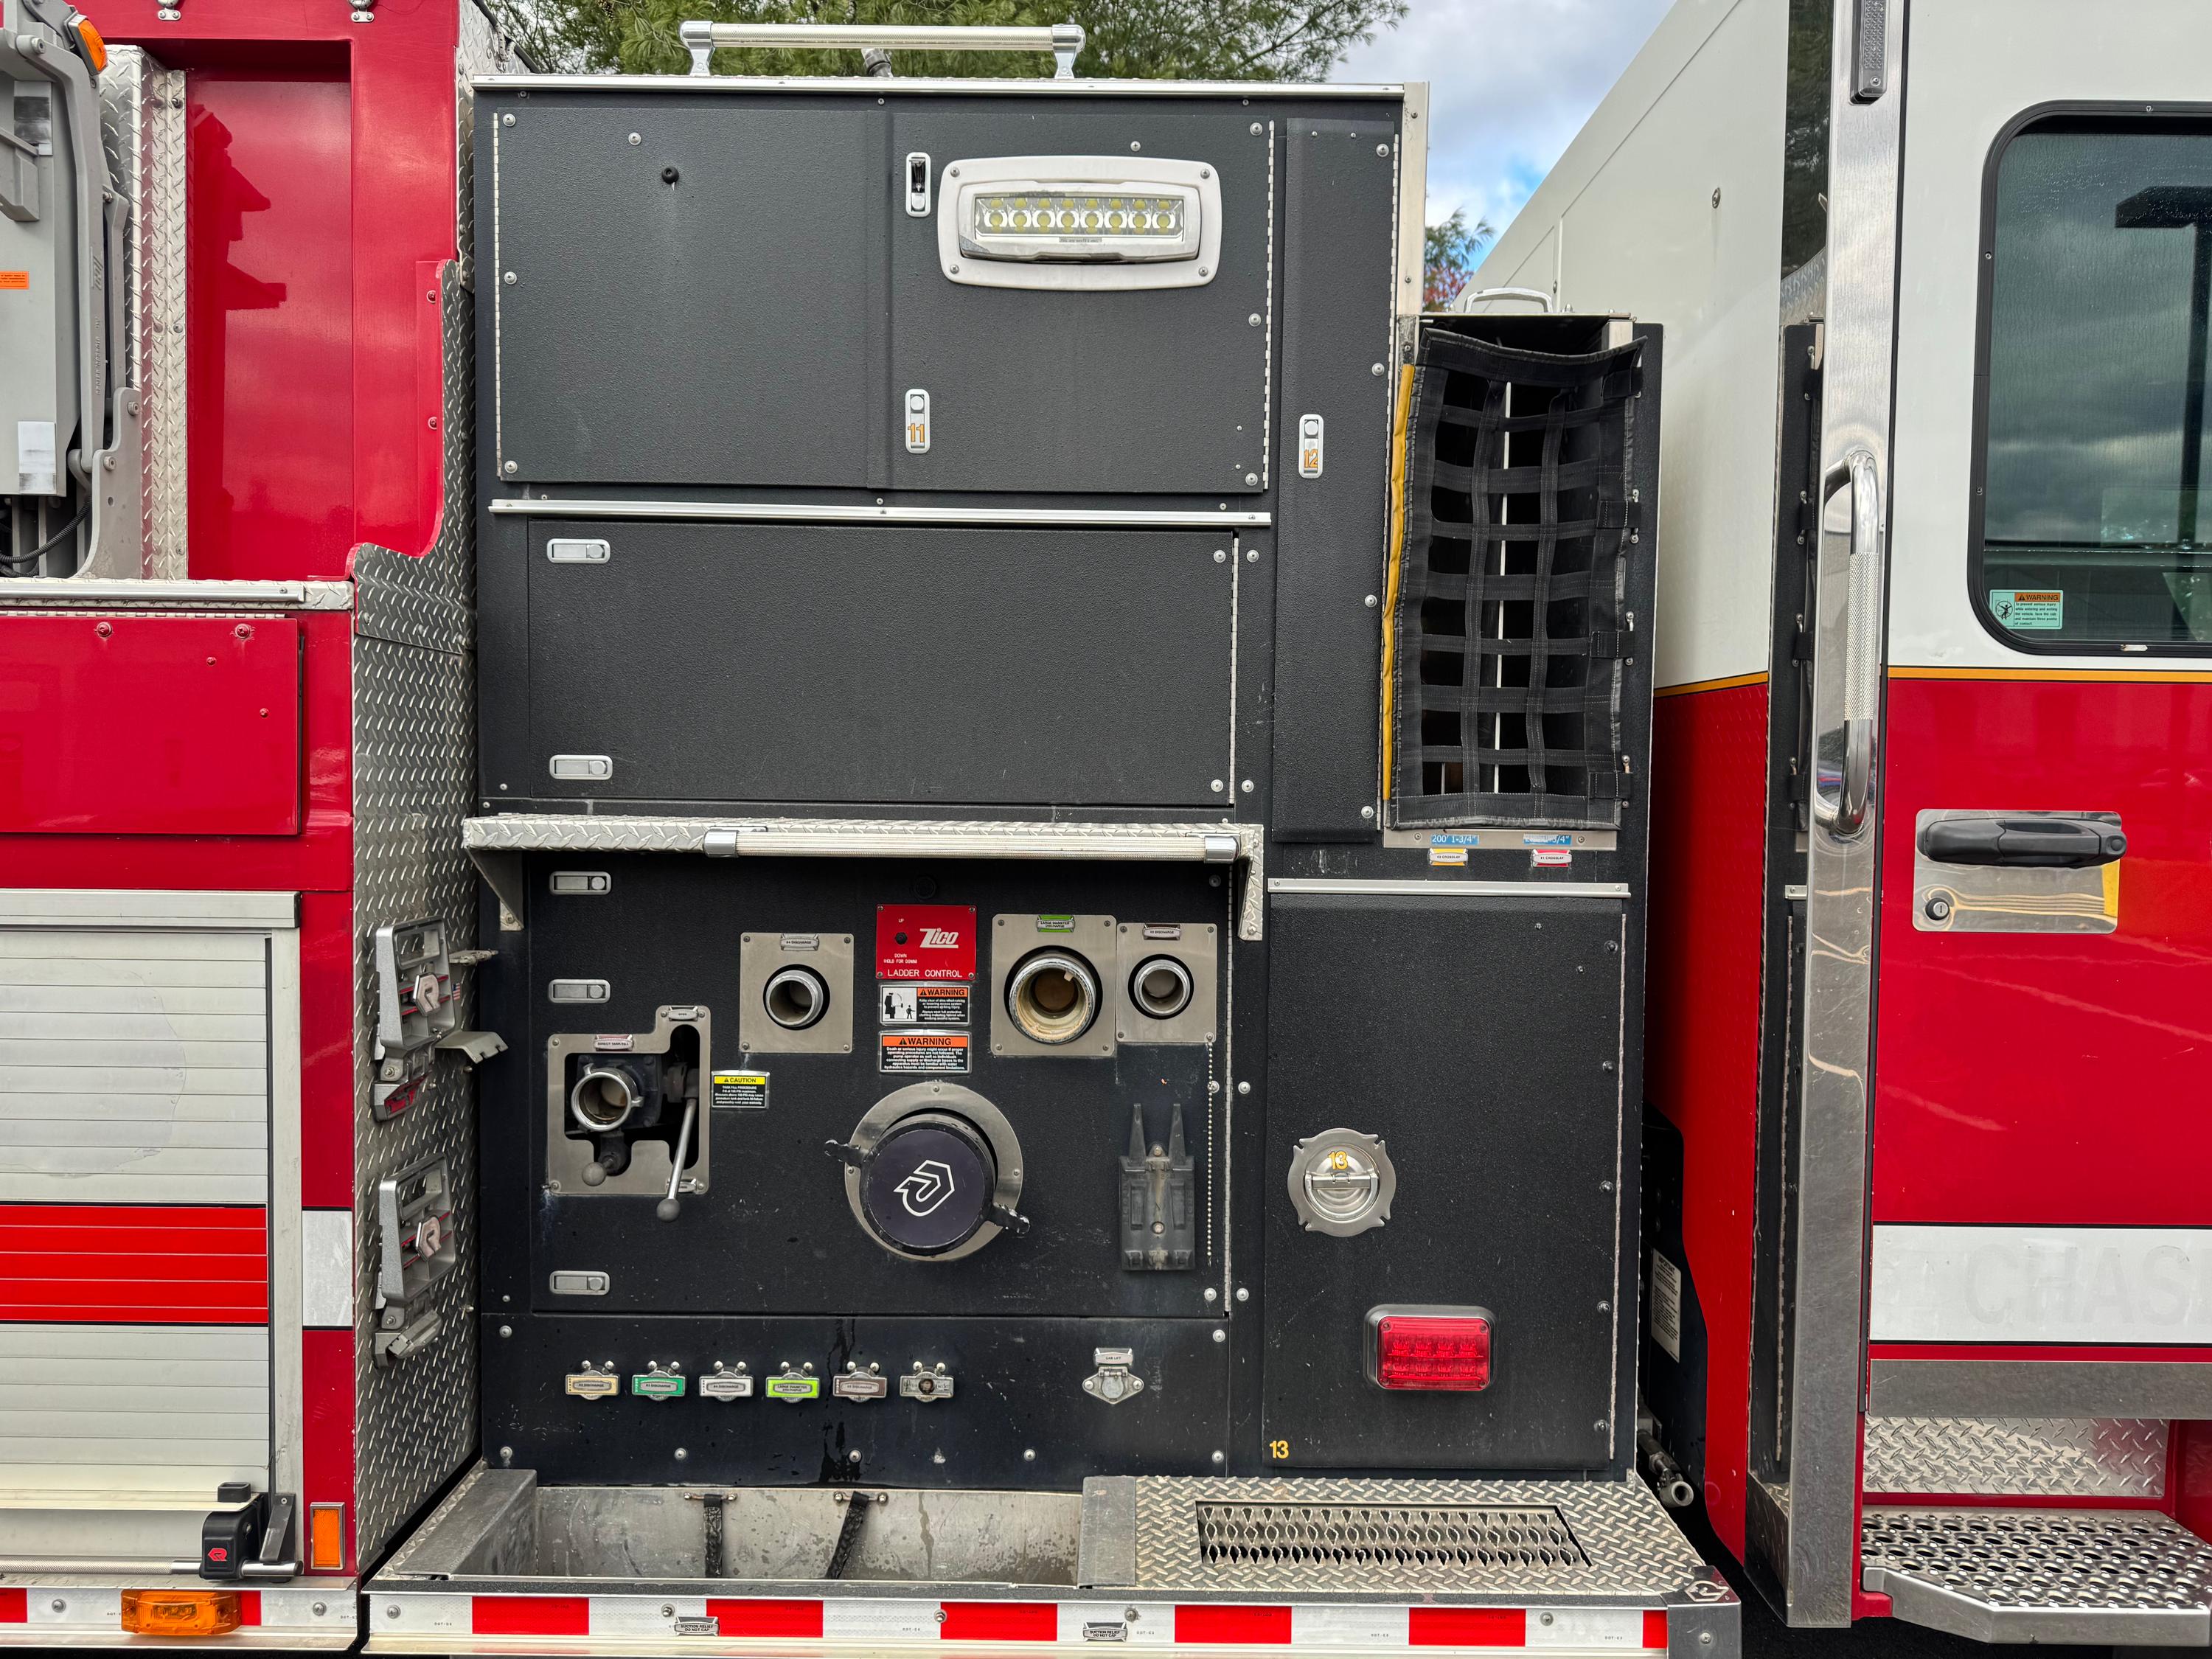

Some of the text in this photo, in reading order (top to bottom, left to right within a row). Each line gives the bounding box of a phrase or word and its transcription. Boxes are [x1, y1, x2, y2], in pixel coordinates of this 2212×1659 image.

[908, 423, 925, 443] 11
[1304, 449, 1318, 468] 12
[1432, 835, 1476, 844] 200' 1-3/4"
[919, 928, 959, 949] Zico
[887, 969, 962, 977] LADDER CONTROL
[1328, 1151, 1348, 1170] 13
[1269, 1440, 1289, 1459] 13
